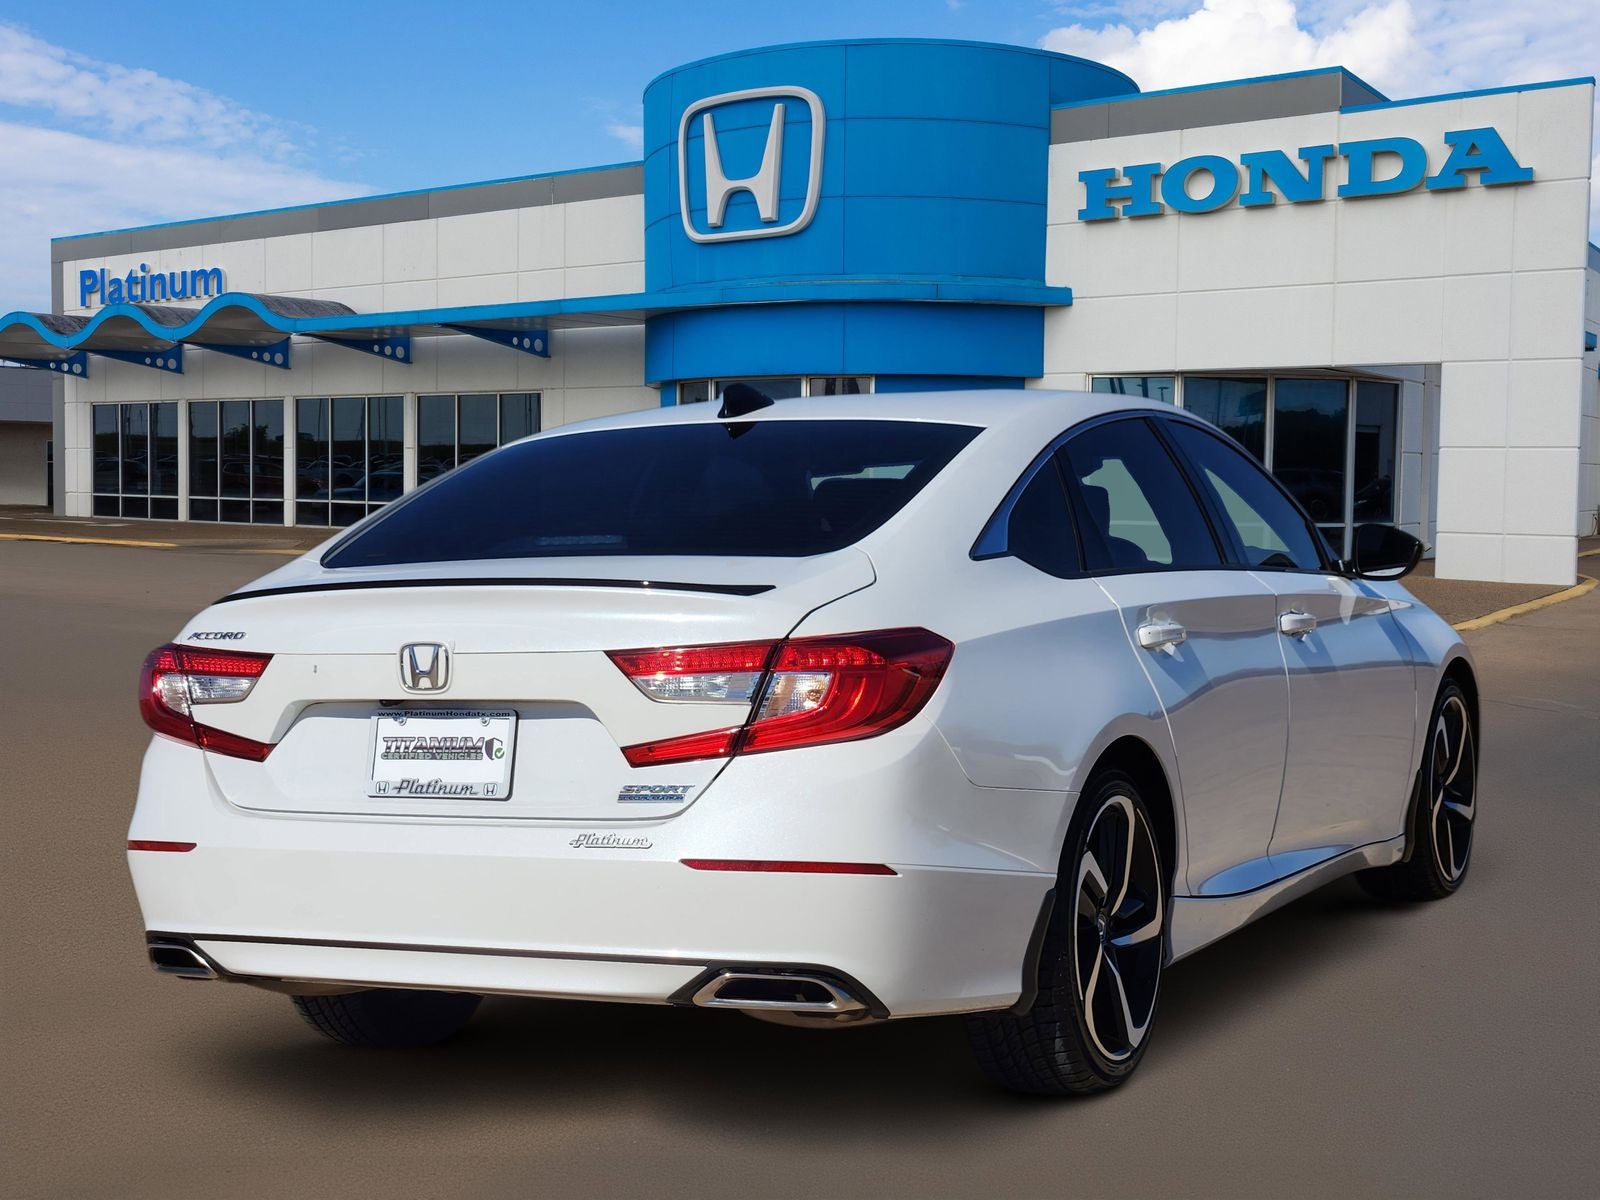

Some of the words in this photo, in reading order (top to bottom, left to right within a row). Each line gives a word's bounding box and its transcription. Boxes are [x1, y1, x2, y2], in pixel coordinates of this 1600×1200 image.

[1077, 126, 1535, 222] HONDA
[79, 263, 225, 307] Platinum
[188, 631, 247, 641] ACCORD
[377, 710, 511, 718] www.PlatinumHondatx.com
[382, 736, 485, 753] TITANIUM
[381, 752, 432, 761] CERTIFIED
[435, 752, 483, 761] VEHICLES
[392, 777, 480, 796] Platinum
[619, 784, 696, 794] SPORT
[569, 832, 653, 850] Platinum
